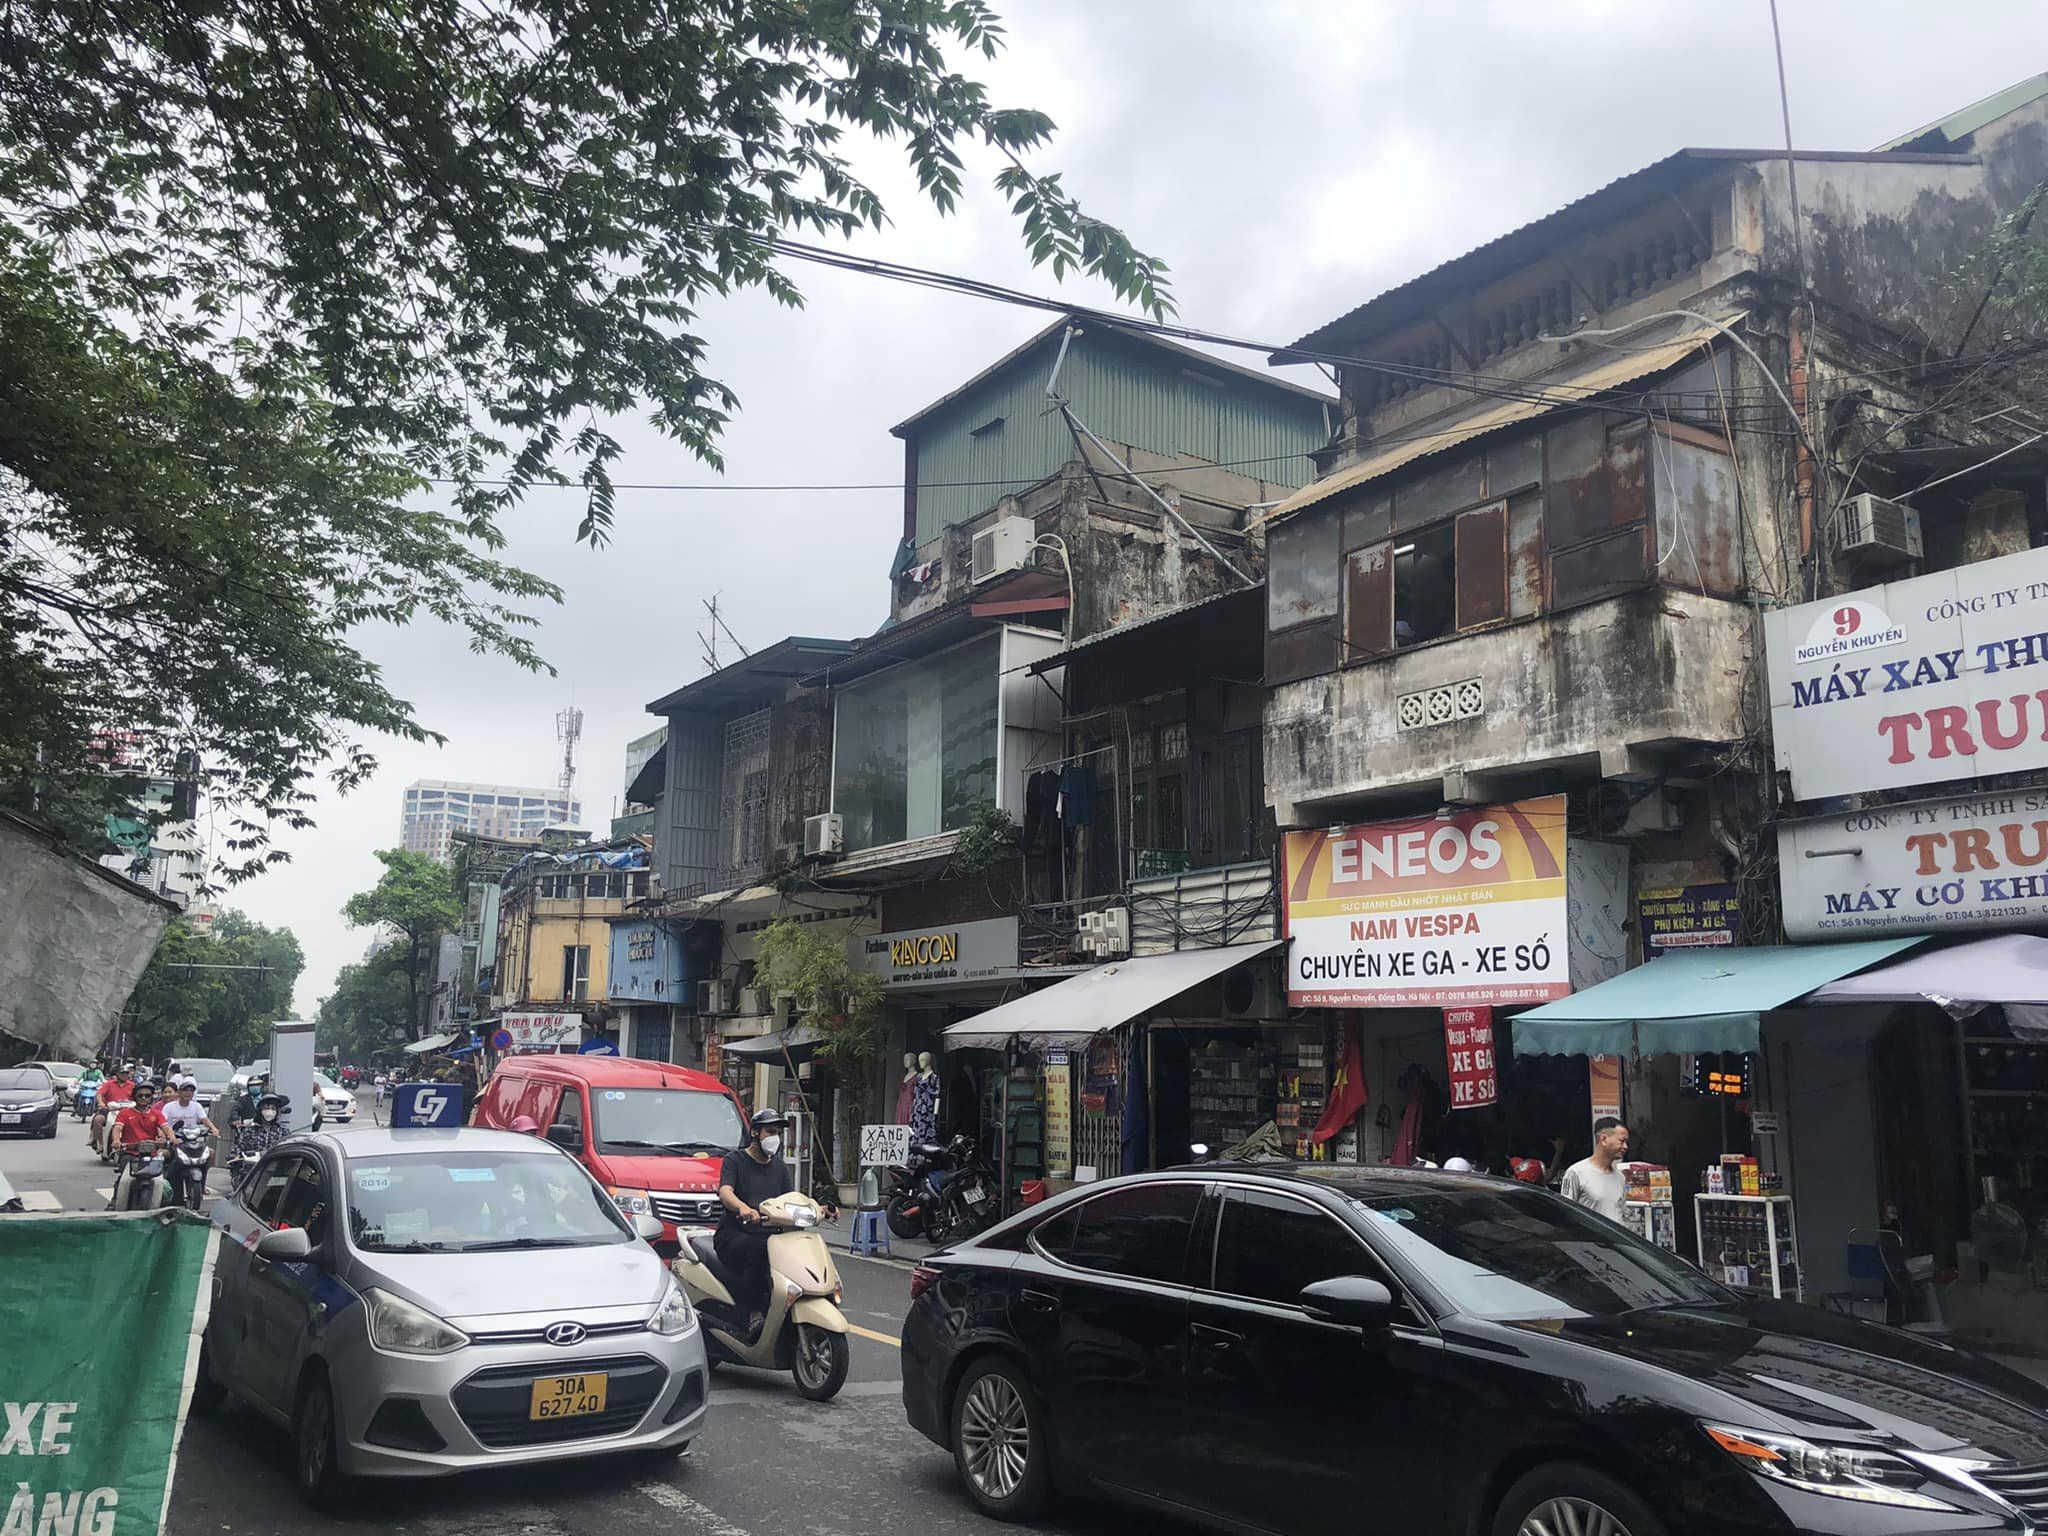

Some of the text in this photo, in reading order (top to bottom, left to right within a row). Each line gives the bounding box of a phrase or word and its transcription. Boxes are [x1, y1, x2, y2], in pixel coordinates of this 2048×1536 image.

[1926, 598, 1985, 622] CÔNG
[1991, 589, 2019, 609] TY
[1833, 607, 1861, 636] 9
[1798, 627, 1903, 660] NGUYỄN KHUYẾN
[1792, 663, 1871, 708] MÁY
[1882, 649, 1964, 693] XAY
[1910, 808, 1938, 824] TY
[1948, 798, 2014, 820] TNHH
[1332, 821, 1501, 883] ENEOS
[1824, 883, 1901, 914] MÁY
[1915, 879, 1964, 906] CƠ
[1350, 912, 1480, 941] NAM VESPA
[1301, 948, 1381, 979] CHUYÊN
[1388, 952, 1415, 976] XE
[1423, 950, 1455, 975] GA
[1476, 946, 1507, 973] XE
[1515, 932, 1550, 971] SỐ
[1452, 1049, 1493, 1073] XE GA
[1454, 1071, 1496, 1102] XE SỐ
[414, 1088, 448, 1123] G7
[860, 1148, 874, 1161] XE
[361, 1179, 388, 1187] 2014
[555, 1377, 585, 1395] 30A
[539, 1395, 598, 1416] 627.40
[0, 1402, 78, 1456] XE
